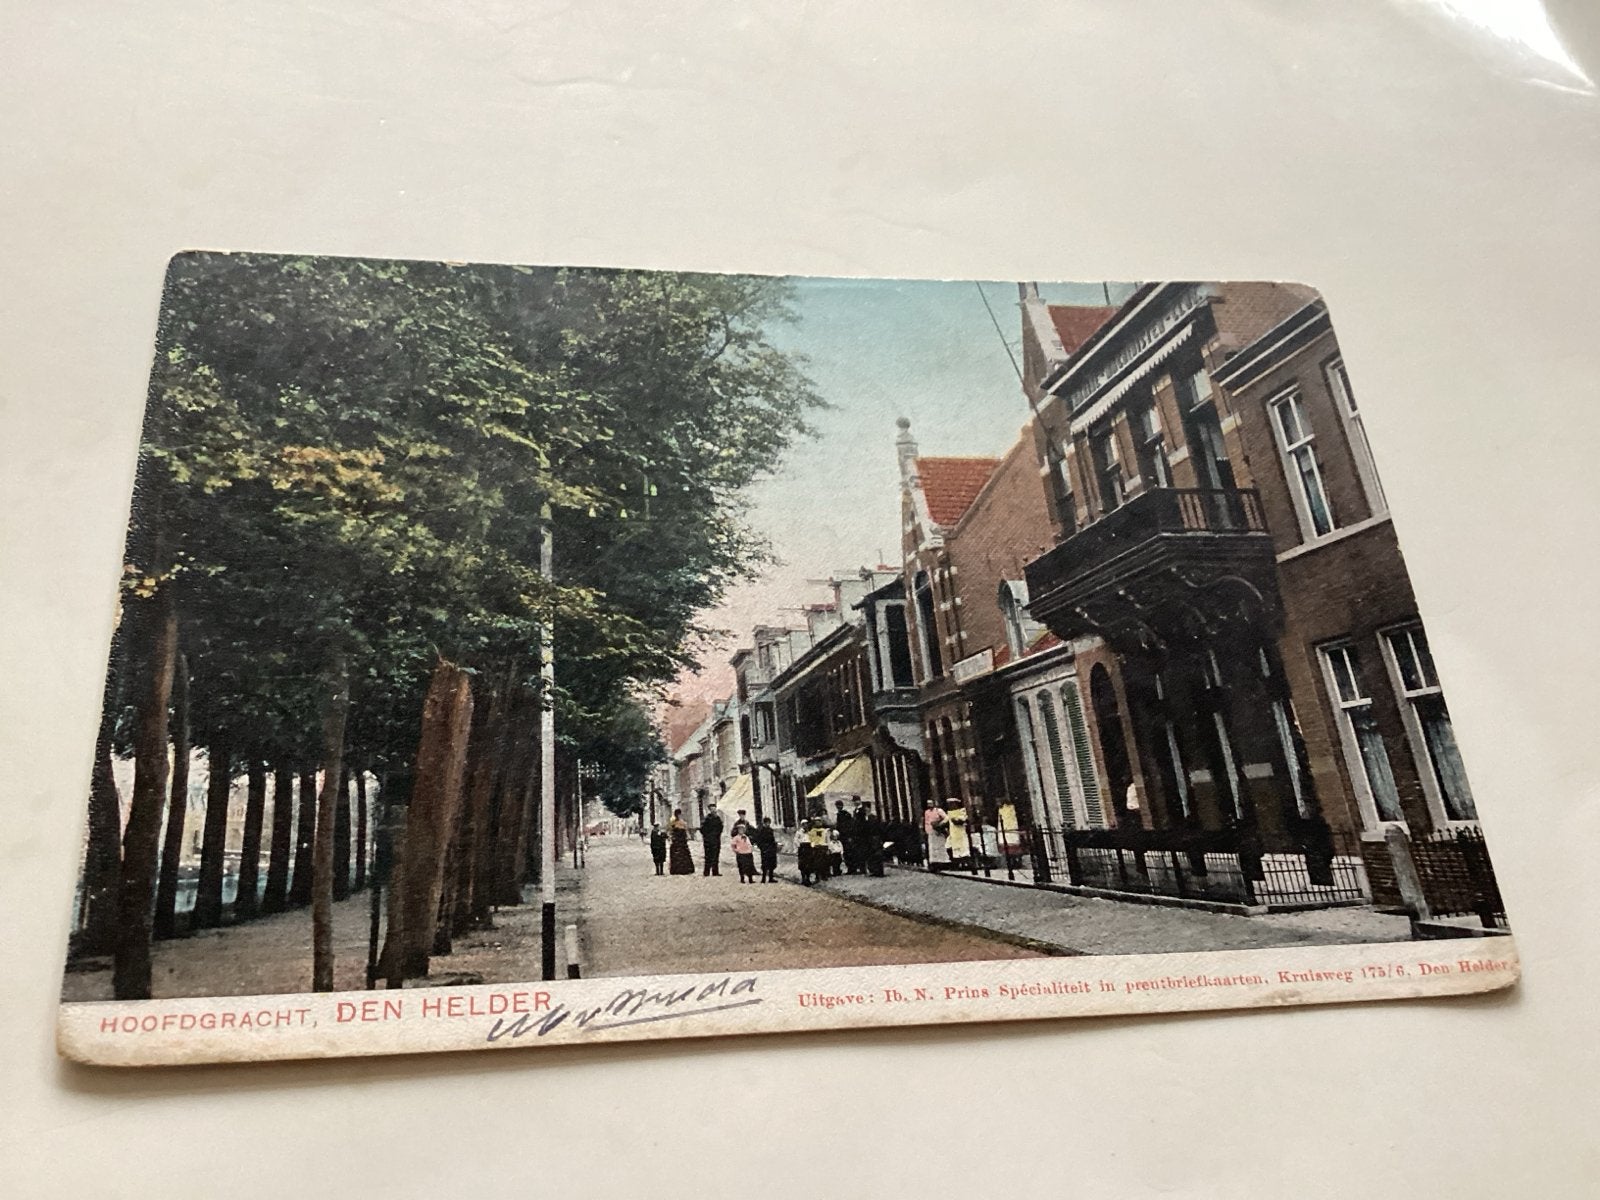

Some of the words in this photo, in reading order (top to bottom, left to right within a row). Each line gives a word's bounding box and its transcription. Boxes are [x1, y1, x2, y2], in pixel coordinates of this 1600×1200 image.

[914, 988, 934, 1002] N.
[943, 986, 990, 1001] Prins
[998, 980, 1091, 1000] Spécialiteit
[1100, 980, 1116, 993] in
[1276, 967, 1354, 985] Kruisweg
[1417, 962, 1450, 976] Den
[99, 1008, 318, 1033] HOOFDGRACHT,
[336, 999, 403, 1024] DEN
[422, 991, 551, 1018] HELDER
